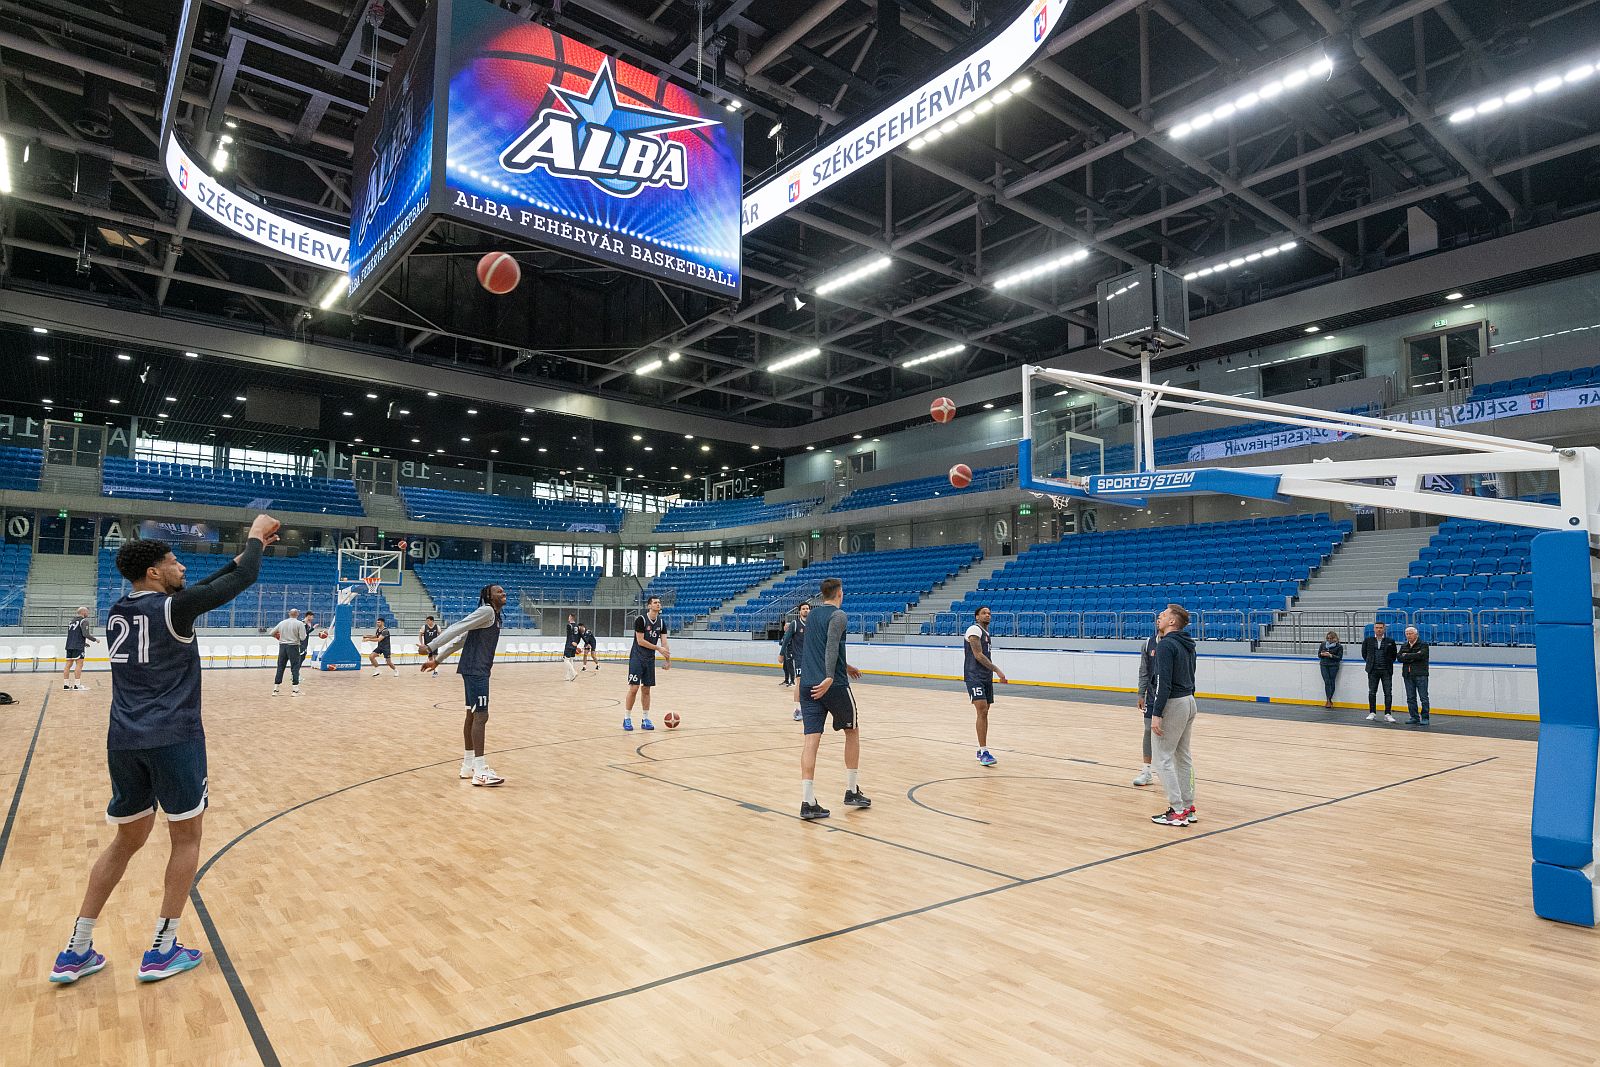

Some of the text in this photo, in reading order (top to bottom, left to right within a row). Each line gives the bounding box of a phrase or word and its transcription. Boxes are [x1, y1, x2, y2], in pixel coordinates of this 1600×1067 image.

[812, 59, 992, 186] SZÉKESFEHÉRVÁR
[508, 113, 686, 187] ALBA
[388, 192, 429, 250] BASKETBALL
[454, 191, 736, 288] ALBA FEHÉRVÁR BASKETBALL
[1097, 472, 1196, 491] SPORTSYSTEM
[107, 614, 149, 664] 21
[478, 696, 487, 707] 11
[628, 674, 638, 682] 96
[972, 687, 983, 697] 15
